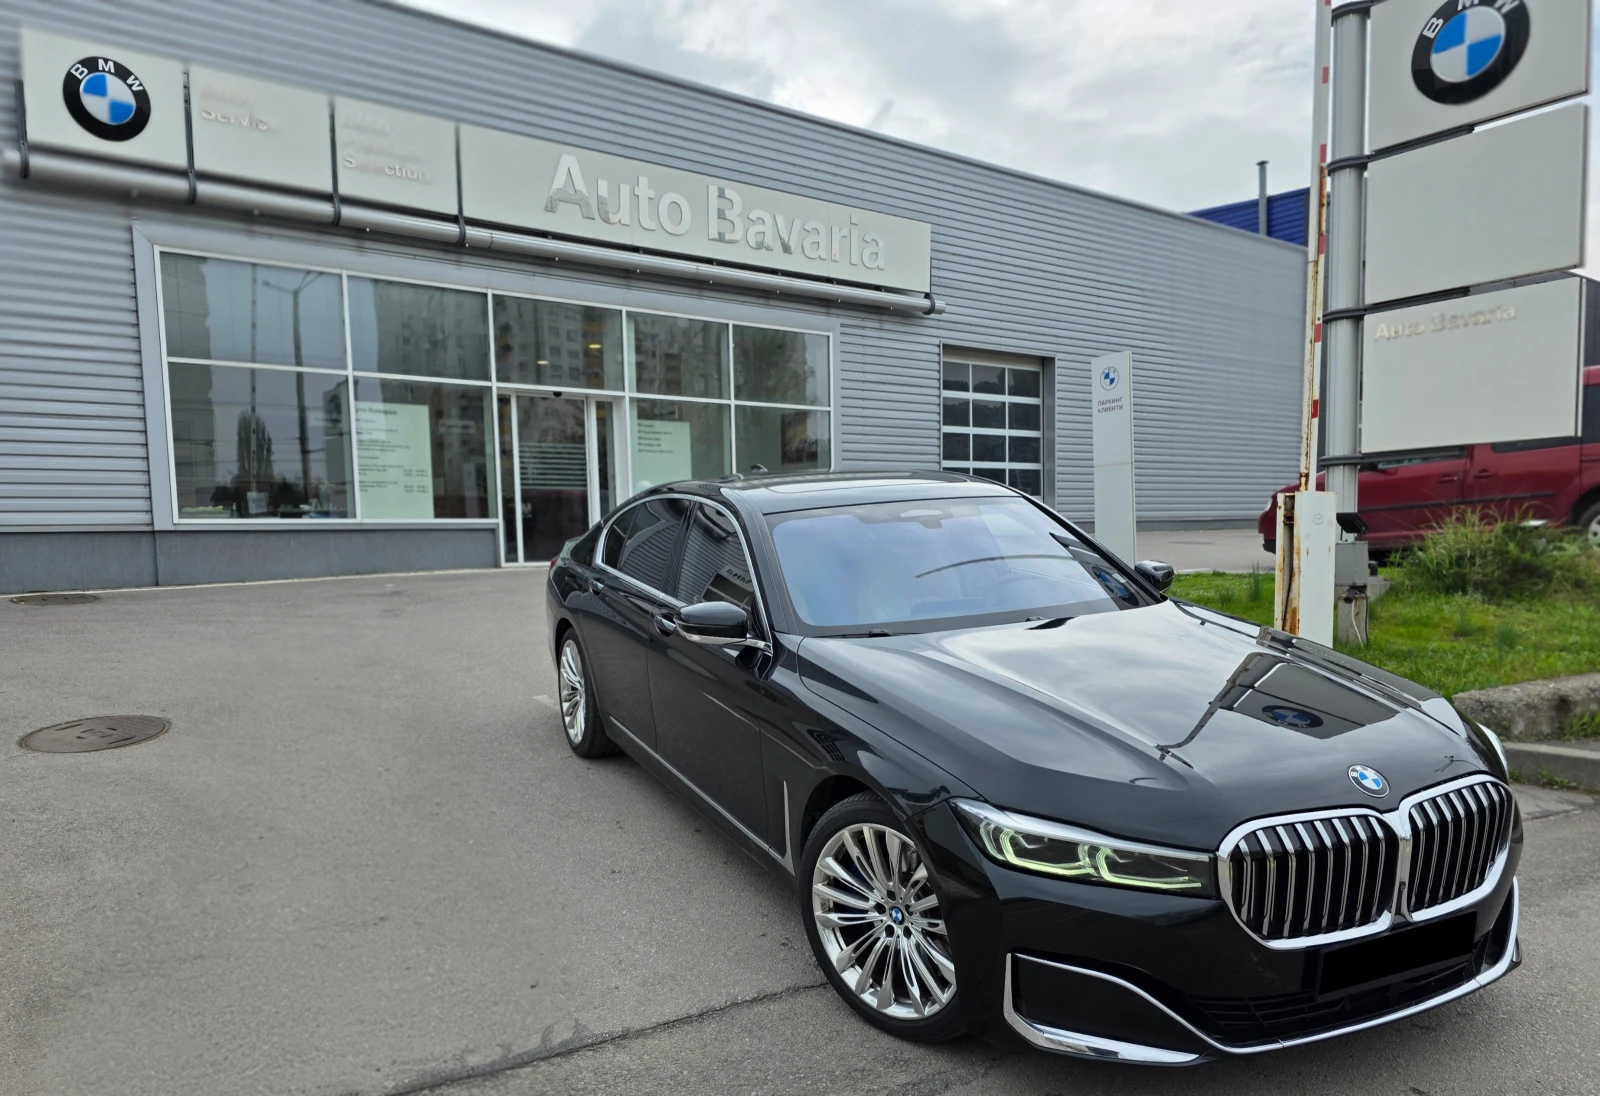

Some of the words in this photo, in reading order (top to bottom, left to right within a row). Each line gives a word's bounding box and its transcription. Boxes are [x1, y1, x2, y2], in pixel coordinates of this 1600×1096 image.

[544, 153, 692, 237] Auto
[707, 184, 886, 270] Bavaria
[1374, 320, 1426, 341] Auto
[1098, 397, 1123, 407] ПАРКИНГ
[1098, 405, 1123, 413] КЛИЕНТИ
